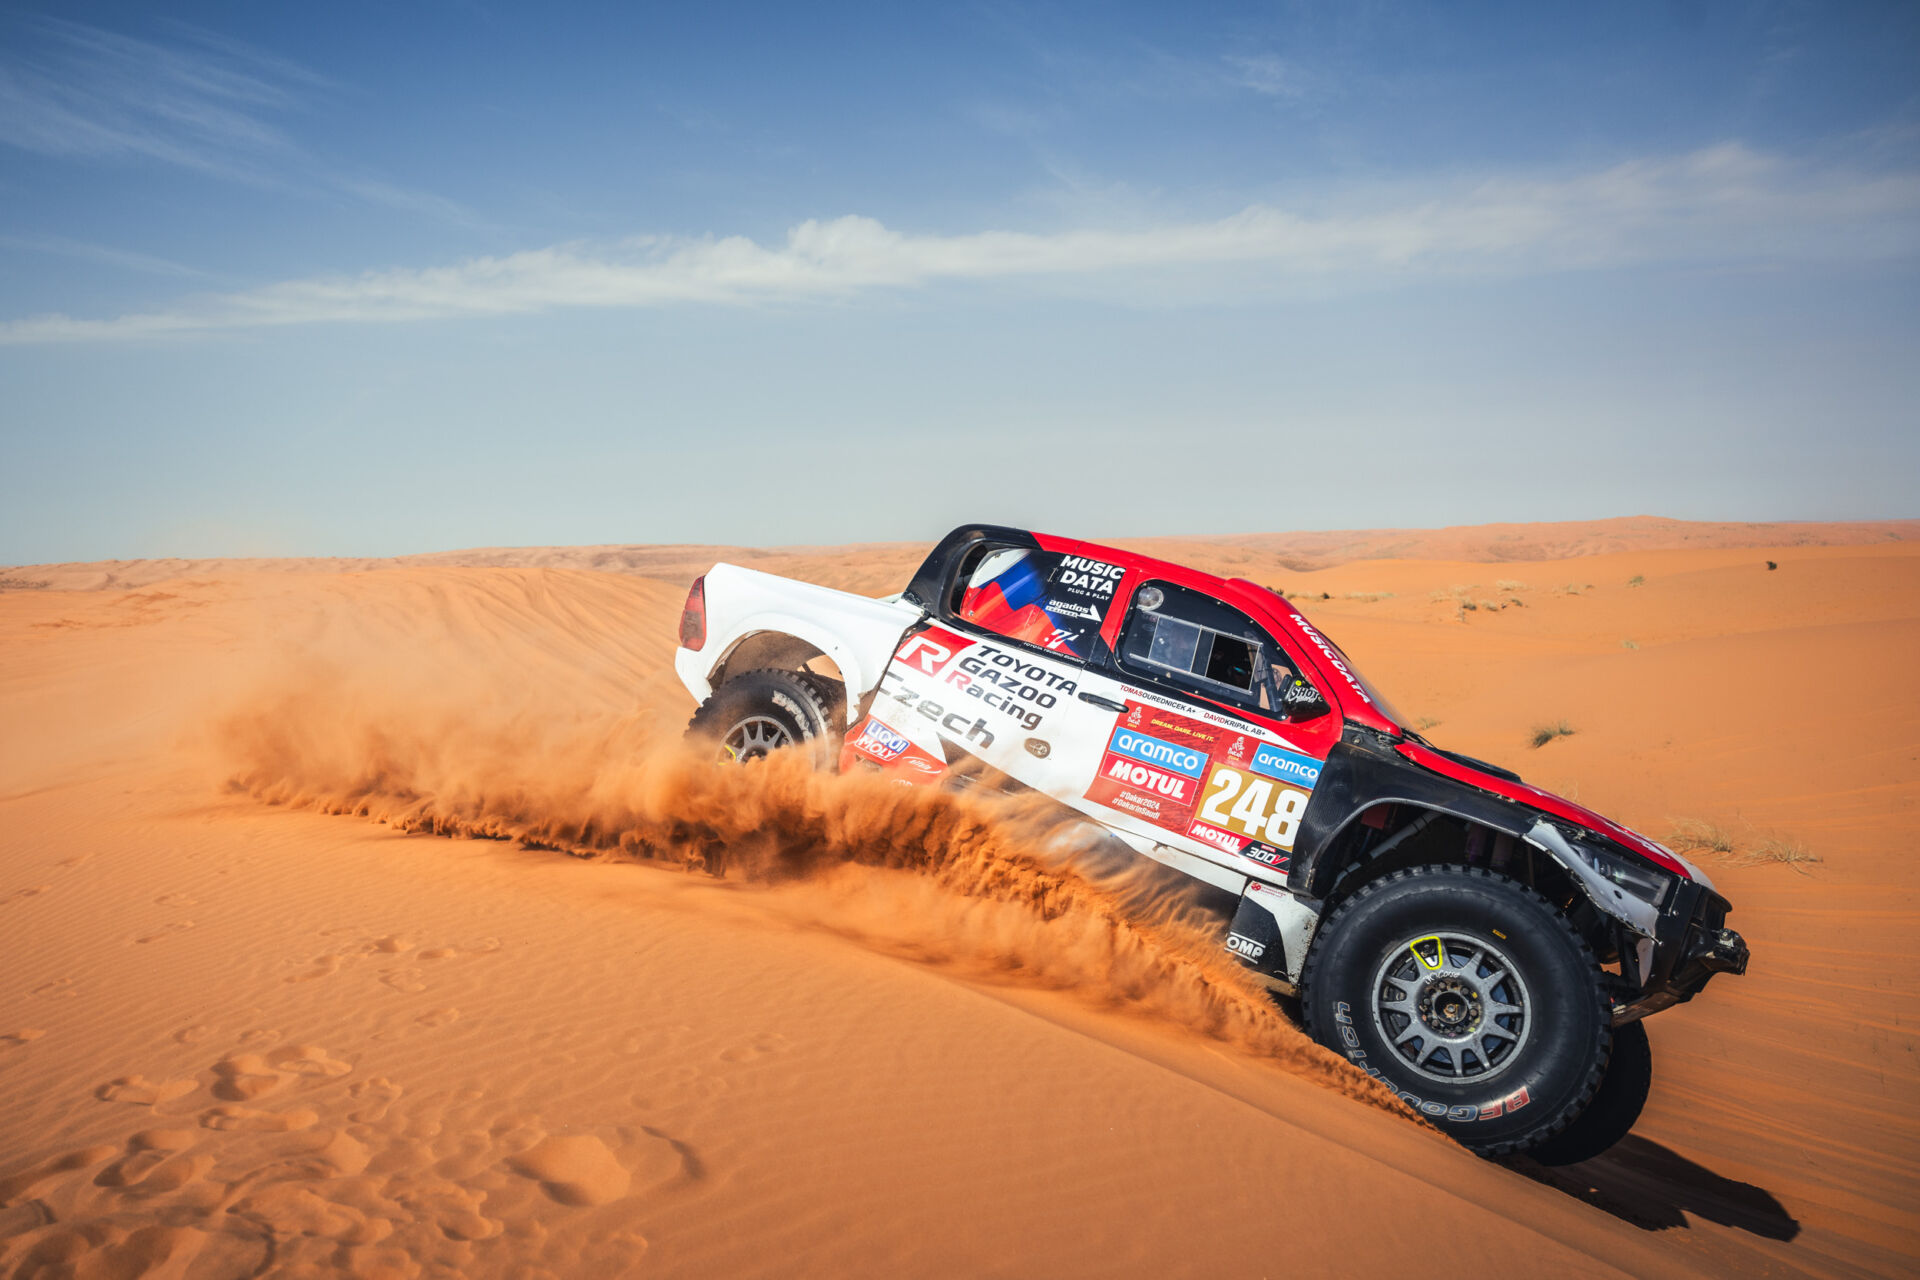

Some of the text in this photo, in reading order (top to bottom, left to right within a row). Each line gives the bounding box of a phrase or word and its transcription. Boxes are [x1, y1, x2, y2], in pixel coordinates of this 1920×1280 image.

[1060, 555, 1126, 580] MUSIC
[1060, 570, 1113, 594] DATA
[1067, 587, 1084, 595] PLUG
[1092, 593, 1110, 601] PLAY
[1049, 599, 1089, 614] agados
[959, 657, 1057, 709] GAZOO
[977, 645, 1077, 696] TOYOTA
[945, 670, 1043, 731] Racing
[857, 734, 897, 759] MOLY
[866, 720, 909, 753] LIQUI
[1118, 734, 1199, 770] aramco
[1258, 752, 1319, 779] aramco
[1109, 760, 1185, 799] MOTUL
[1200, 768, 1309, 847] 248
[1191, 824, 1242, 851] MOTUL
[1246, 846, 1290, 866] 300V
[1226, 936, 1264, 959] OMP
